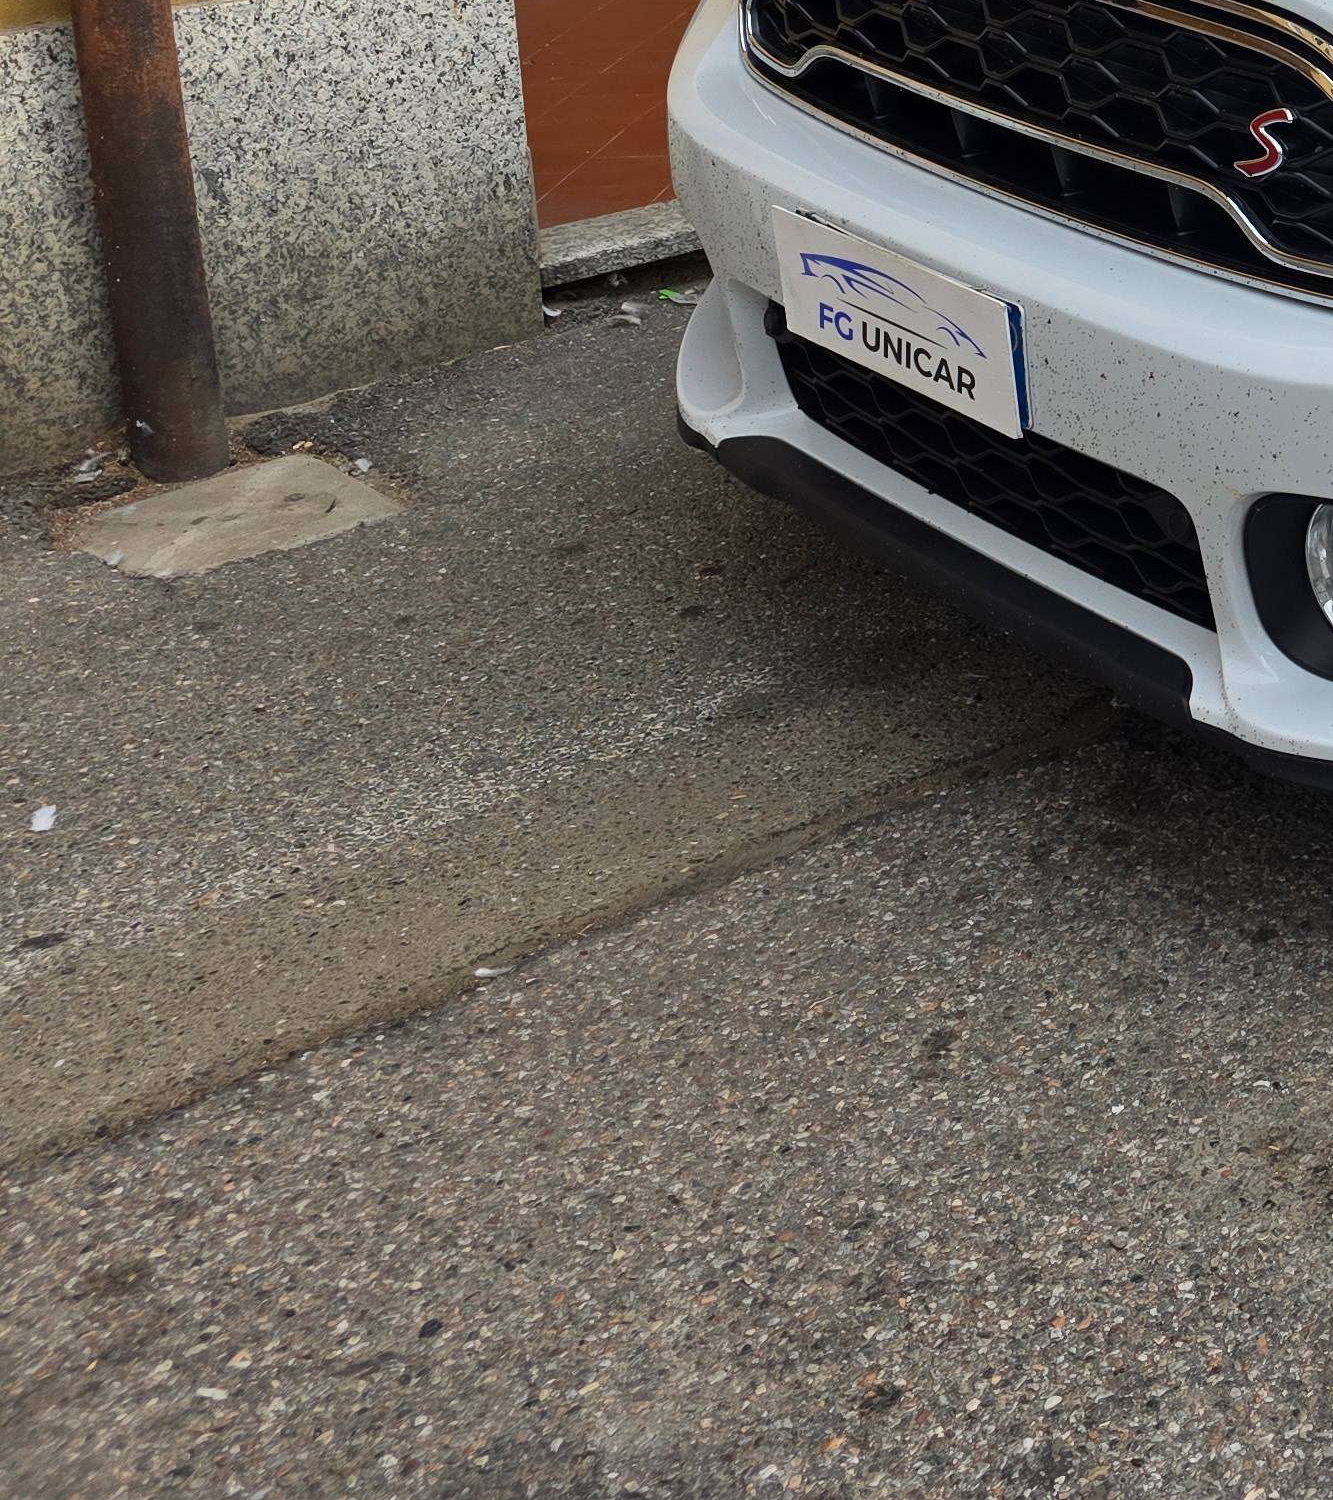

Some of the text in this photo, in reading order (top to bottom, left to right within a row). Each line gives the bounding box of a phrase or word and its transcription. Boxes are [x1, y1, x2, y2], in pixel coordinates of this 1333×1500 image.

[1233, 107, 1293, 177] S
[819, 302, 976, 401] FG UNICAR
